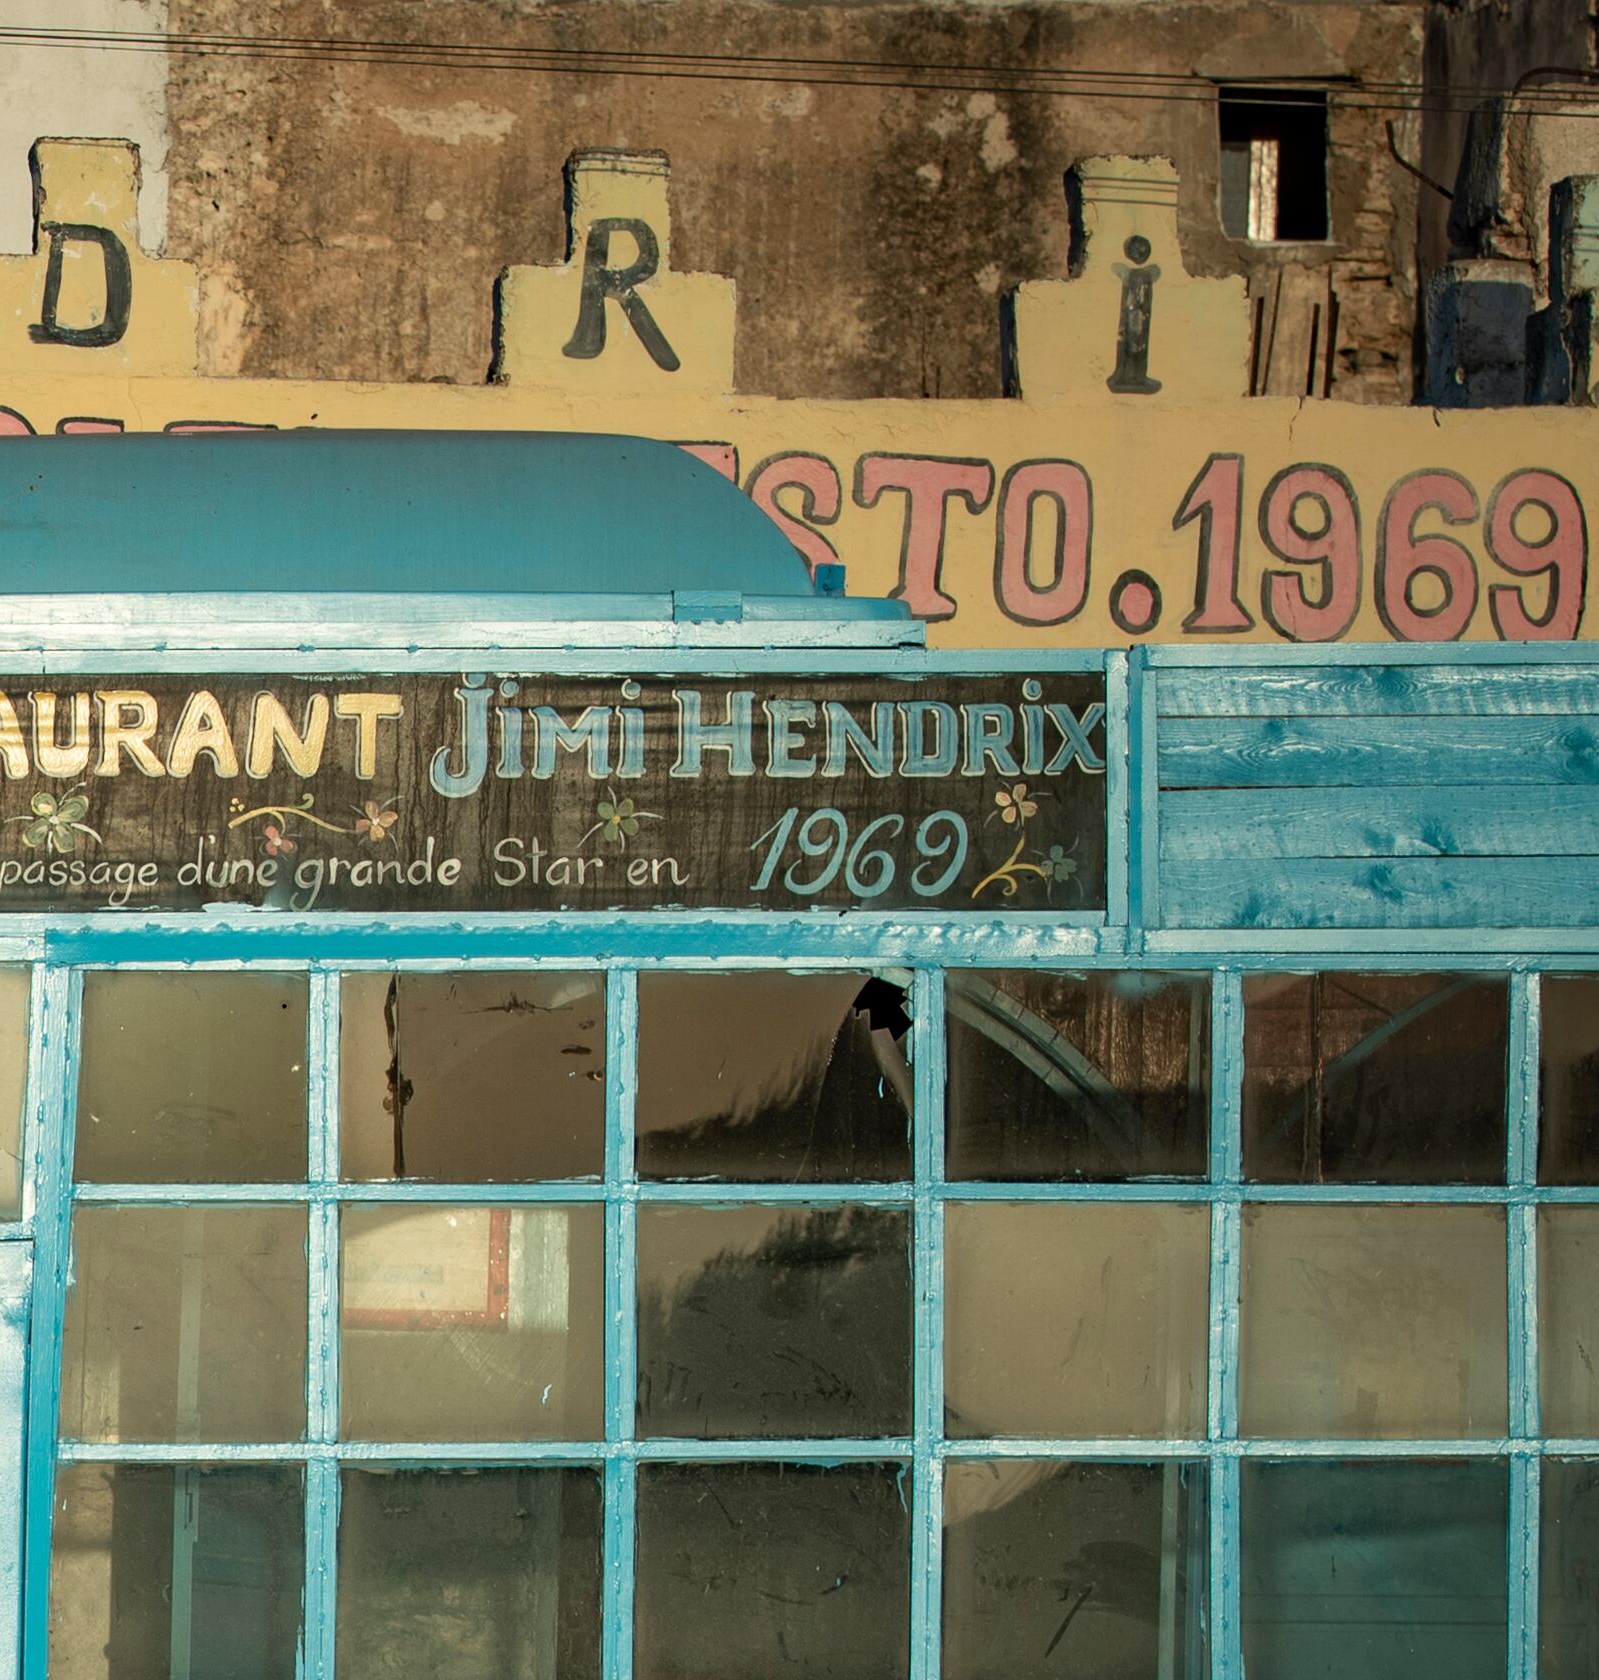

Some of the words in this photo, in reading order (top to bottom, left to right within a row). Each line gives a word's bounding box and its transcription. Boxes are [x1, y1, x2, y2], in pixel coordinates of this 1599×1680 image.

[294, 836, 463, 912] grande
[494, 836, 604, 886] Star
[626, 856, 690, 886] en
[749, 806, 969, 898] 1969
